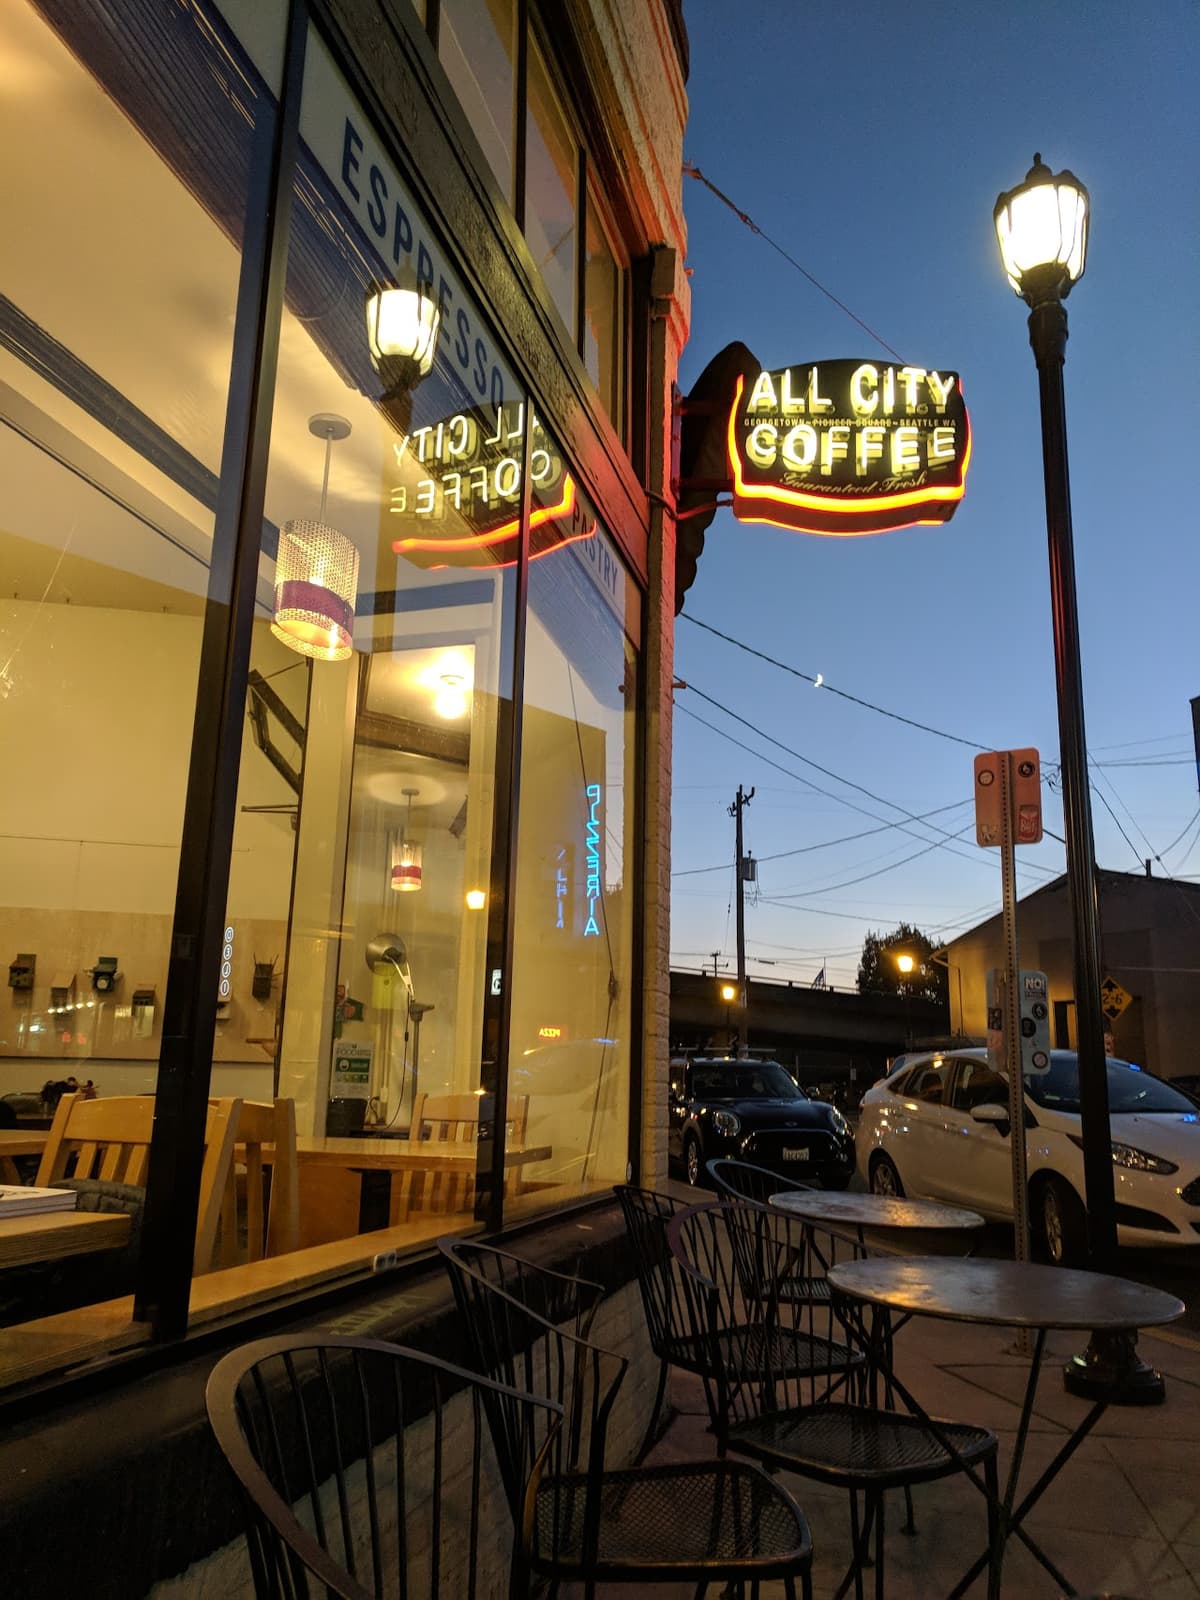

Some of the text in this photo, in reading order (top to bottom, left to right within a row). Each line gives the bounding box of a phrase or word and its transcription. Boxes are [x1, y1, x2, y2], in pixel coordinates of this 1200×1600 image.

[341, 116, 504, 420] ESPRESSO
[746, 364, 955, 415] ALL CITY
[744, 418, 805, 427] GEORGETOWN
[899, 418, 938, 427] SEATTLE
[943, 418, 956, 427] WA
[745, 424, 956, 475] COFFEE
[779, 470, 928, 493] Guaranteed Fresh
[573, 501, 618, 596] PASTRY
